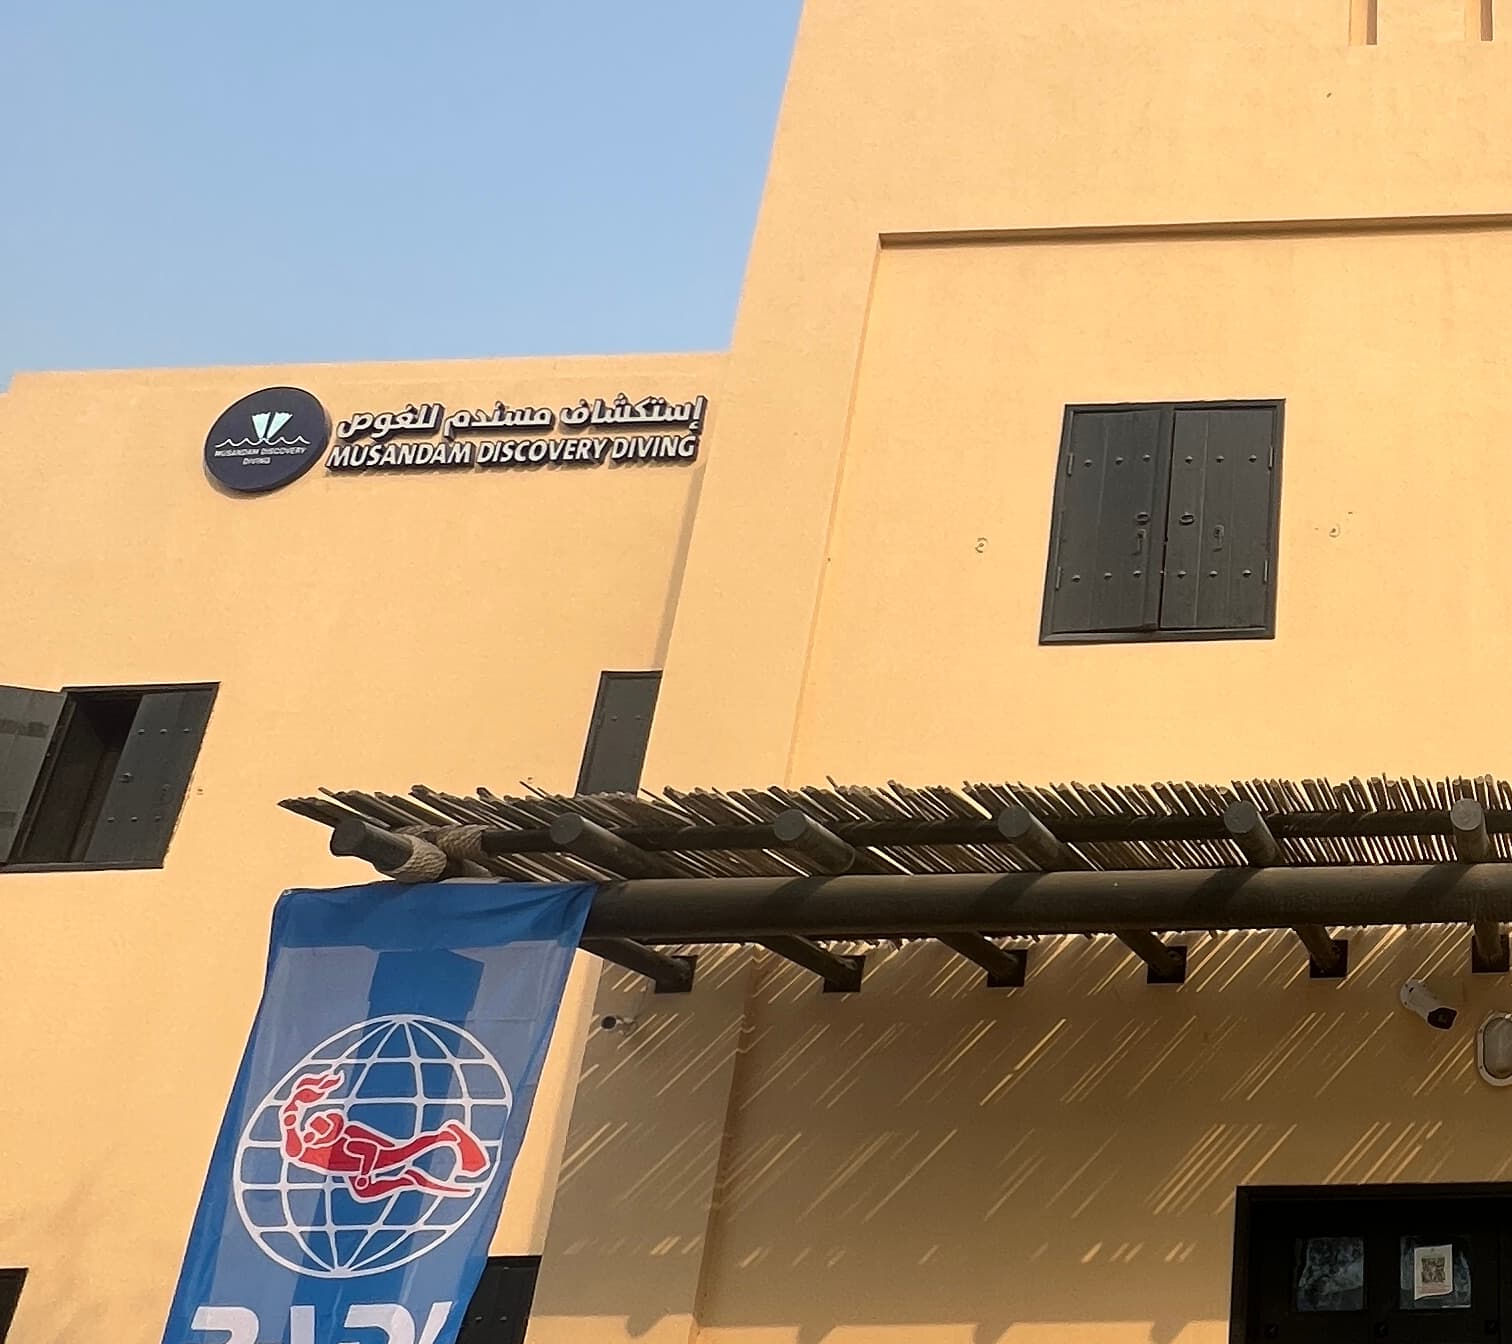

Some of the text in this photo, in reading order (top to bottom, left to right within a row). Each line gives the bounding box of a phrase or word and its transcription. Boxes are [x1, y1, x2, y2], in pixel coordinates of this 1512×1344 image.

[336, 393, 705, 438] إستكشاف مسندم للغوص
[260, 446, 307, 456] DISCOVERY
[326, 435, 698, 467] MUSANDAM DISCOVERY DIVING
